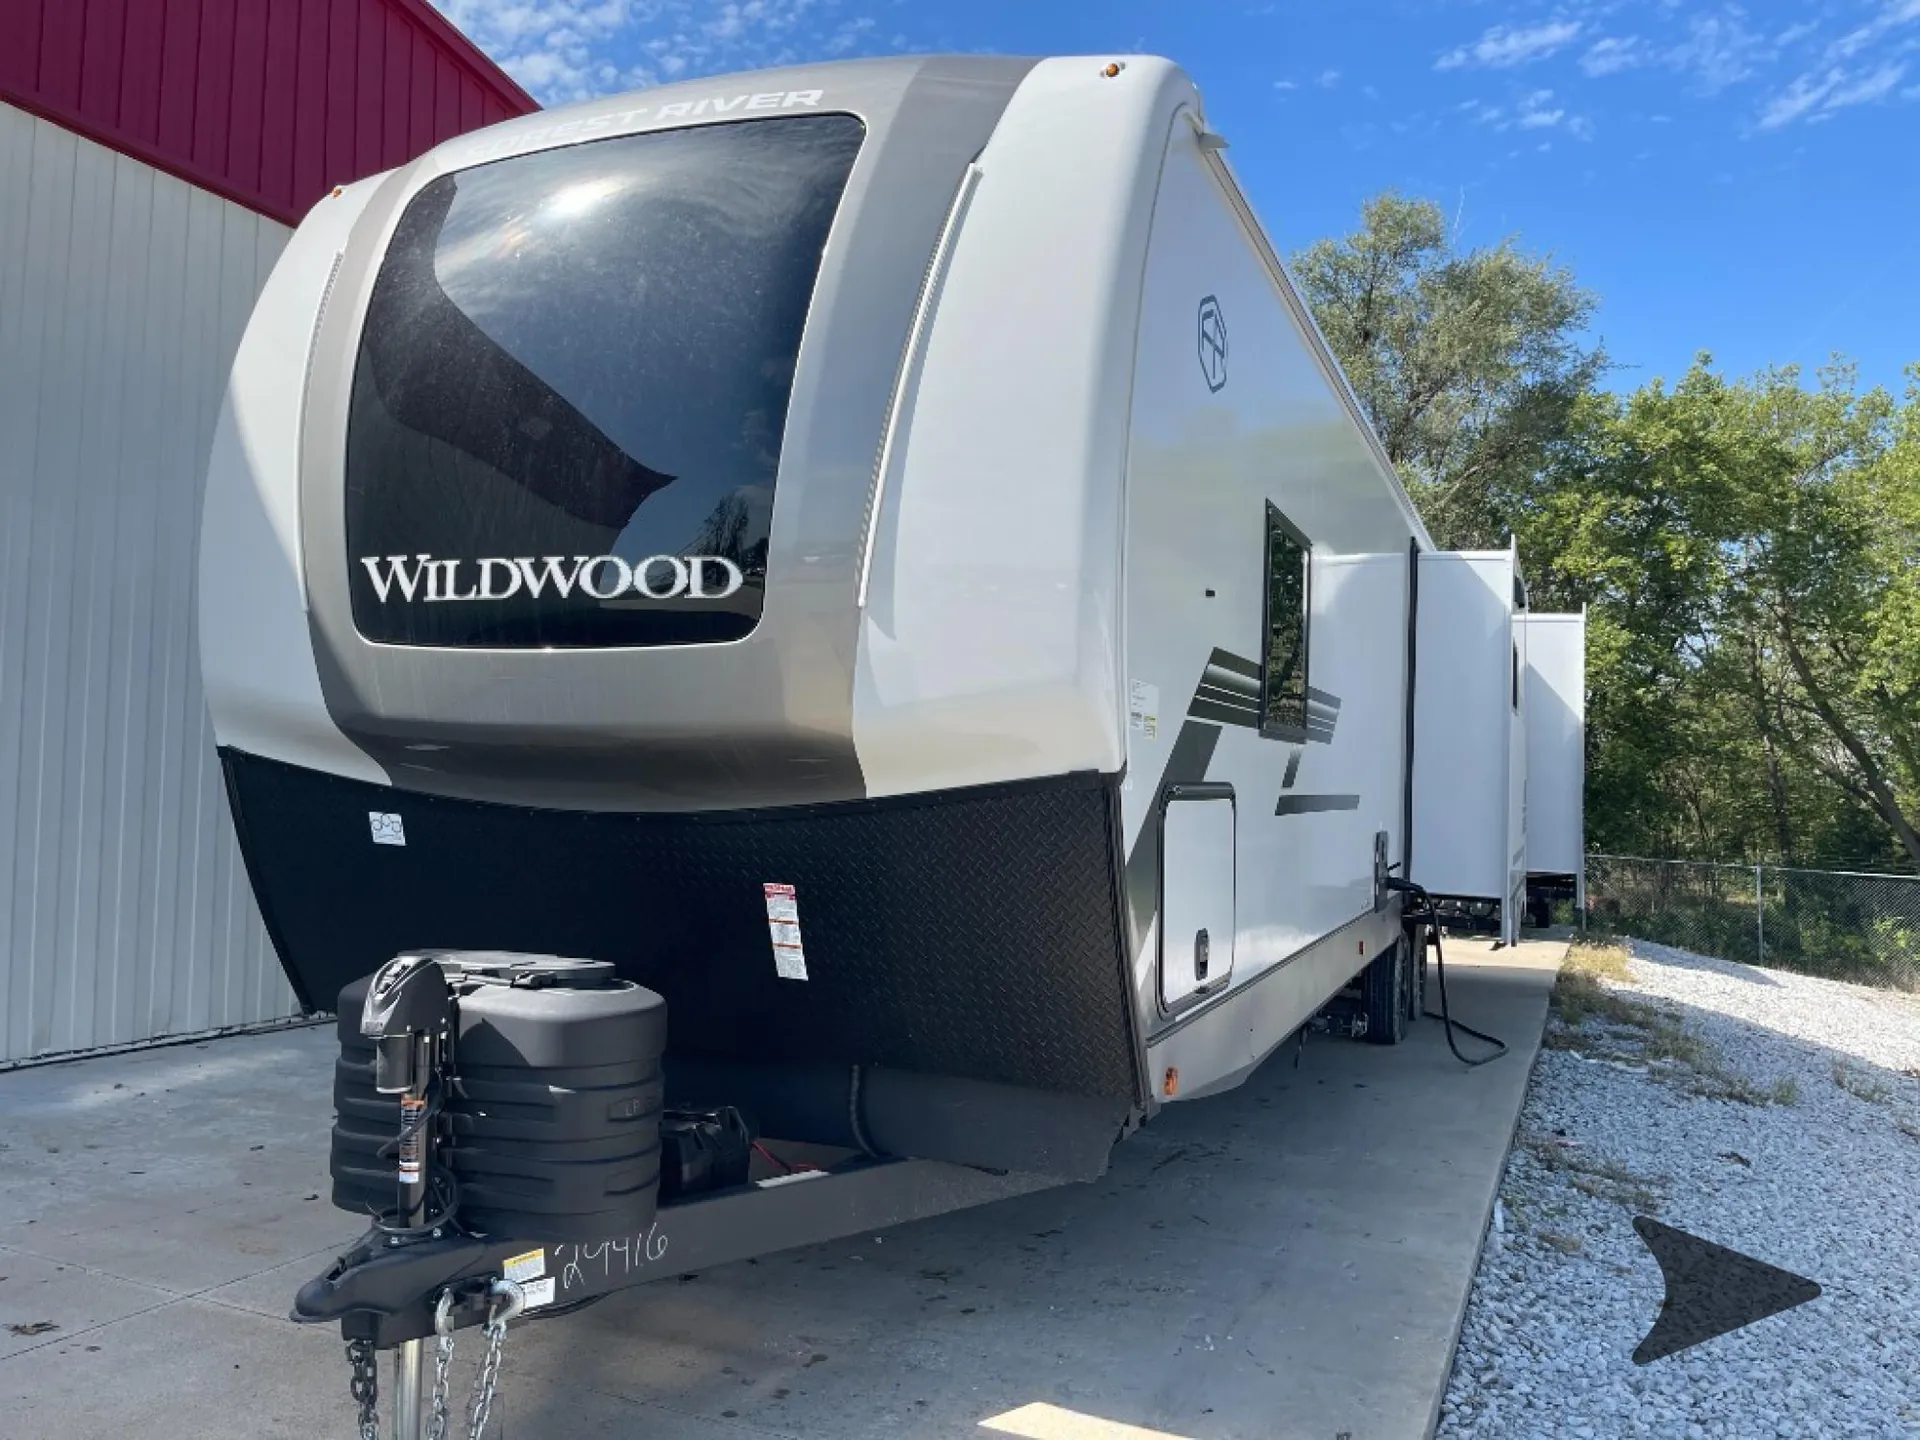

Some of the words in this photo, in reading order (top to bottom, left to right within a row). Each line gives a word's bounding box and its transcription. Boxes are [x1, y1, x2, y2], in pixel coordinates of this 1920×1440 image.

[466, 107, 649, 159] FOREST
[653, 88, 825, 122] RIVER
[361, 554, 743, 602] WILDWOOD
